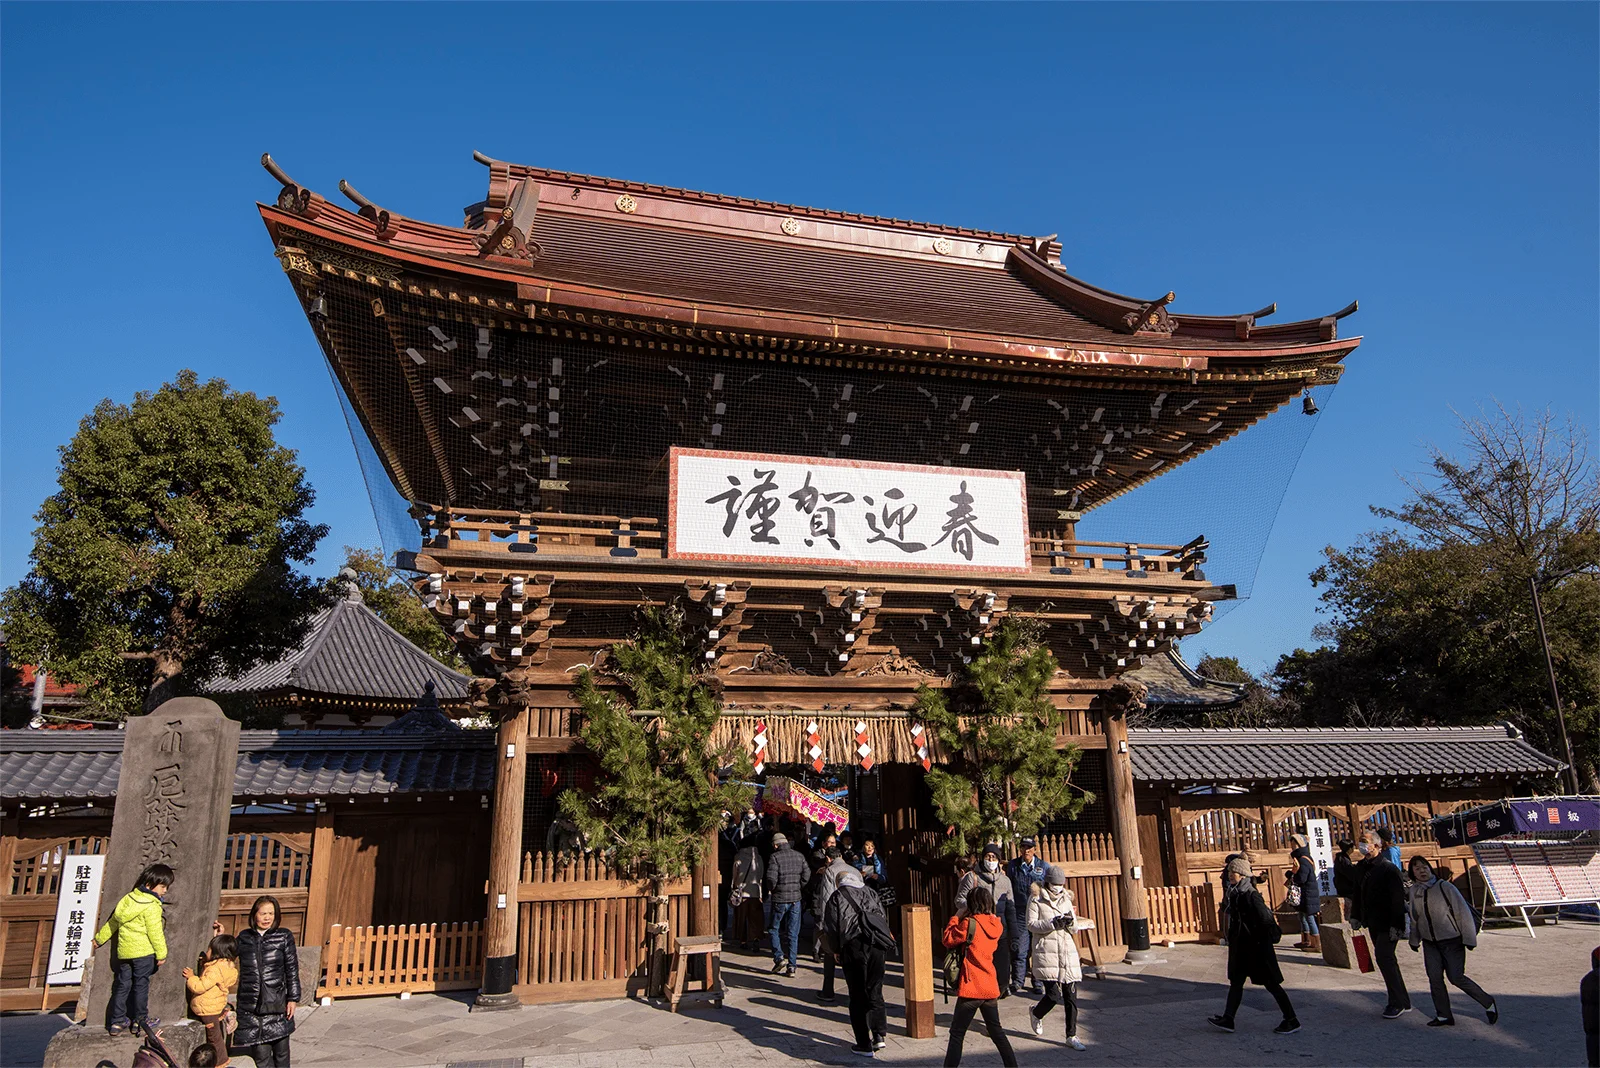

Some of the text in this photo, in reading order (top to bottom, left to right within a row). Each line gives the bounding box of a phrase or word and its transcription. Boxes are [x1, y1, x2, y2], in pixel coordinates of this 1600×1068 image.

[704, 468, 1000, 561] 謹賀迎春
[62, 865, 92, 971] 駐車・駐輪禁止
